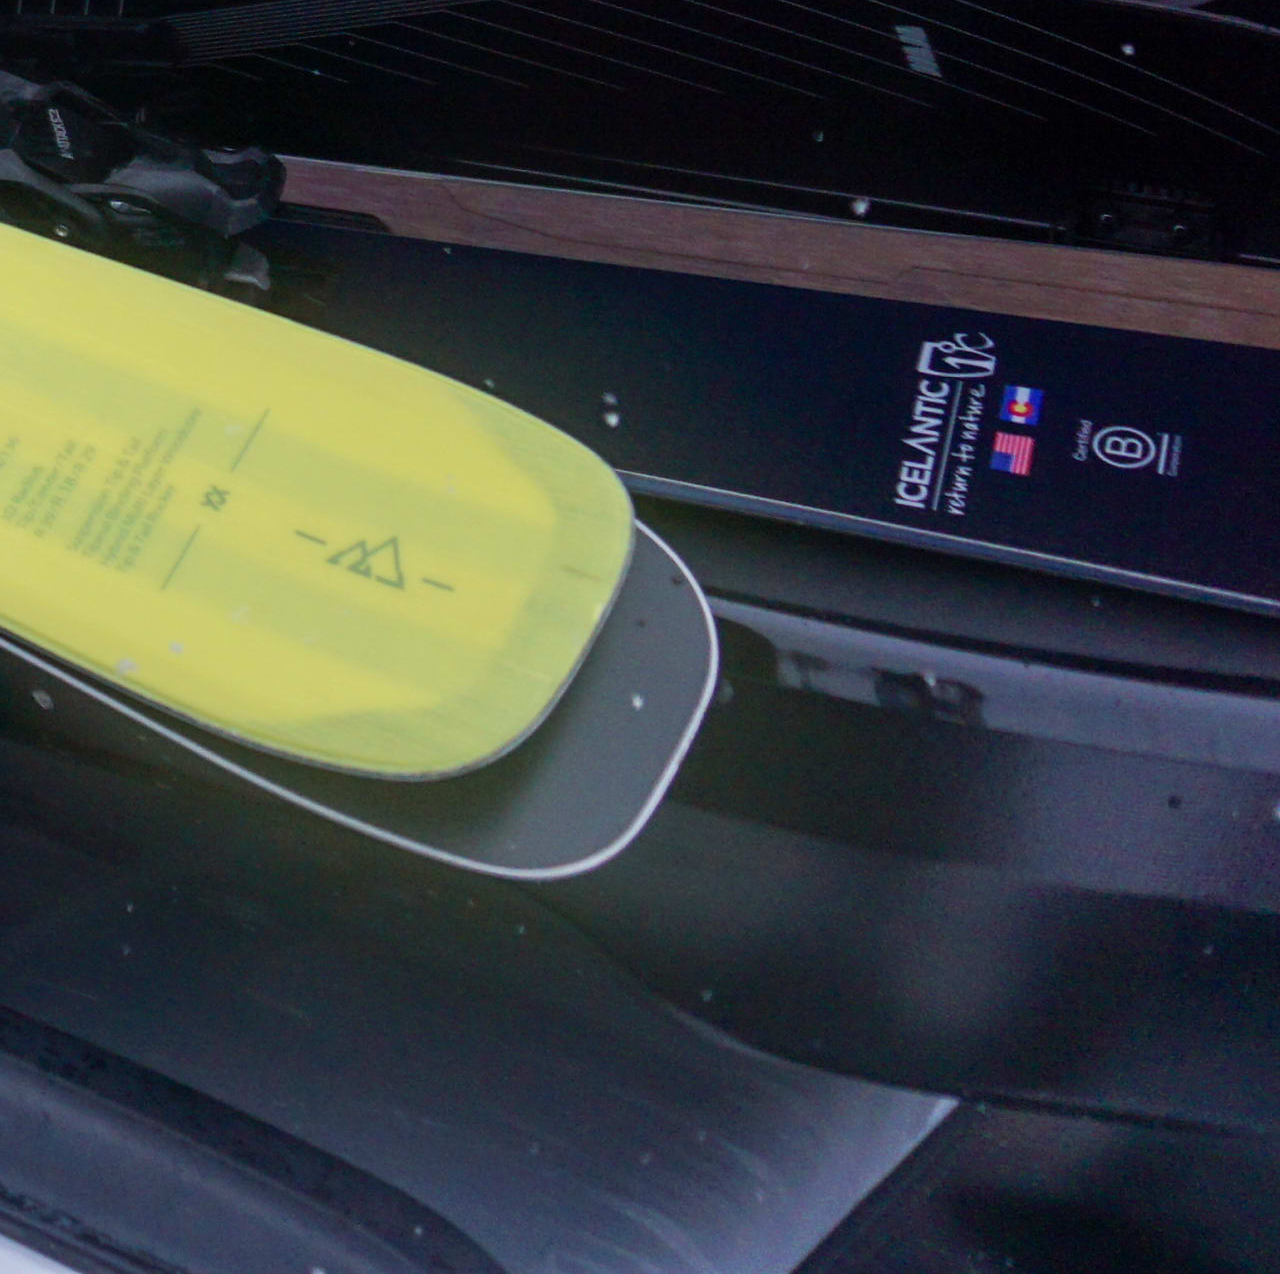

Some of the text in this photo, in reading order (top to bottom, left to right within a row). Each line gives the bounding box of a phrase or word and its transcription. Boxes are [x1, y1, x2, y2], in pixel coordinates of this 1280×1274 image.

[895, 379, 950, 509] ICELANTIC
[945, 383, 987, 516] return to nature
[1105, 435, 1143, 459] B
